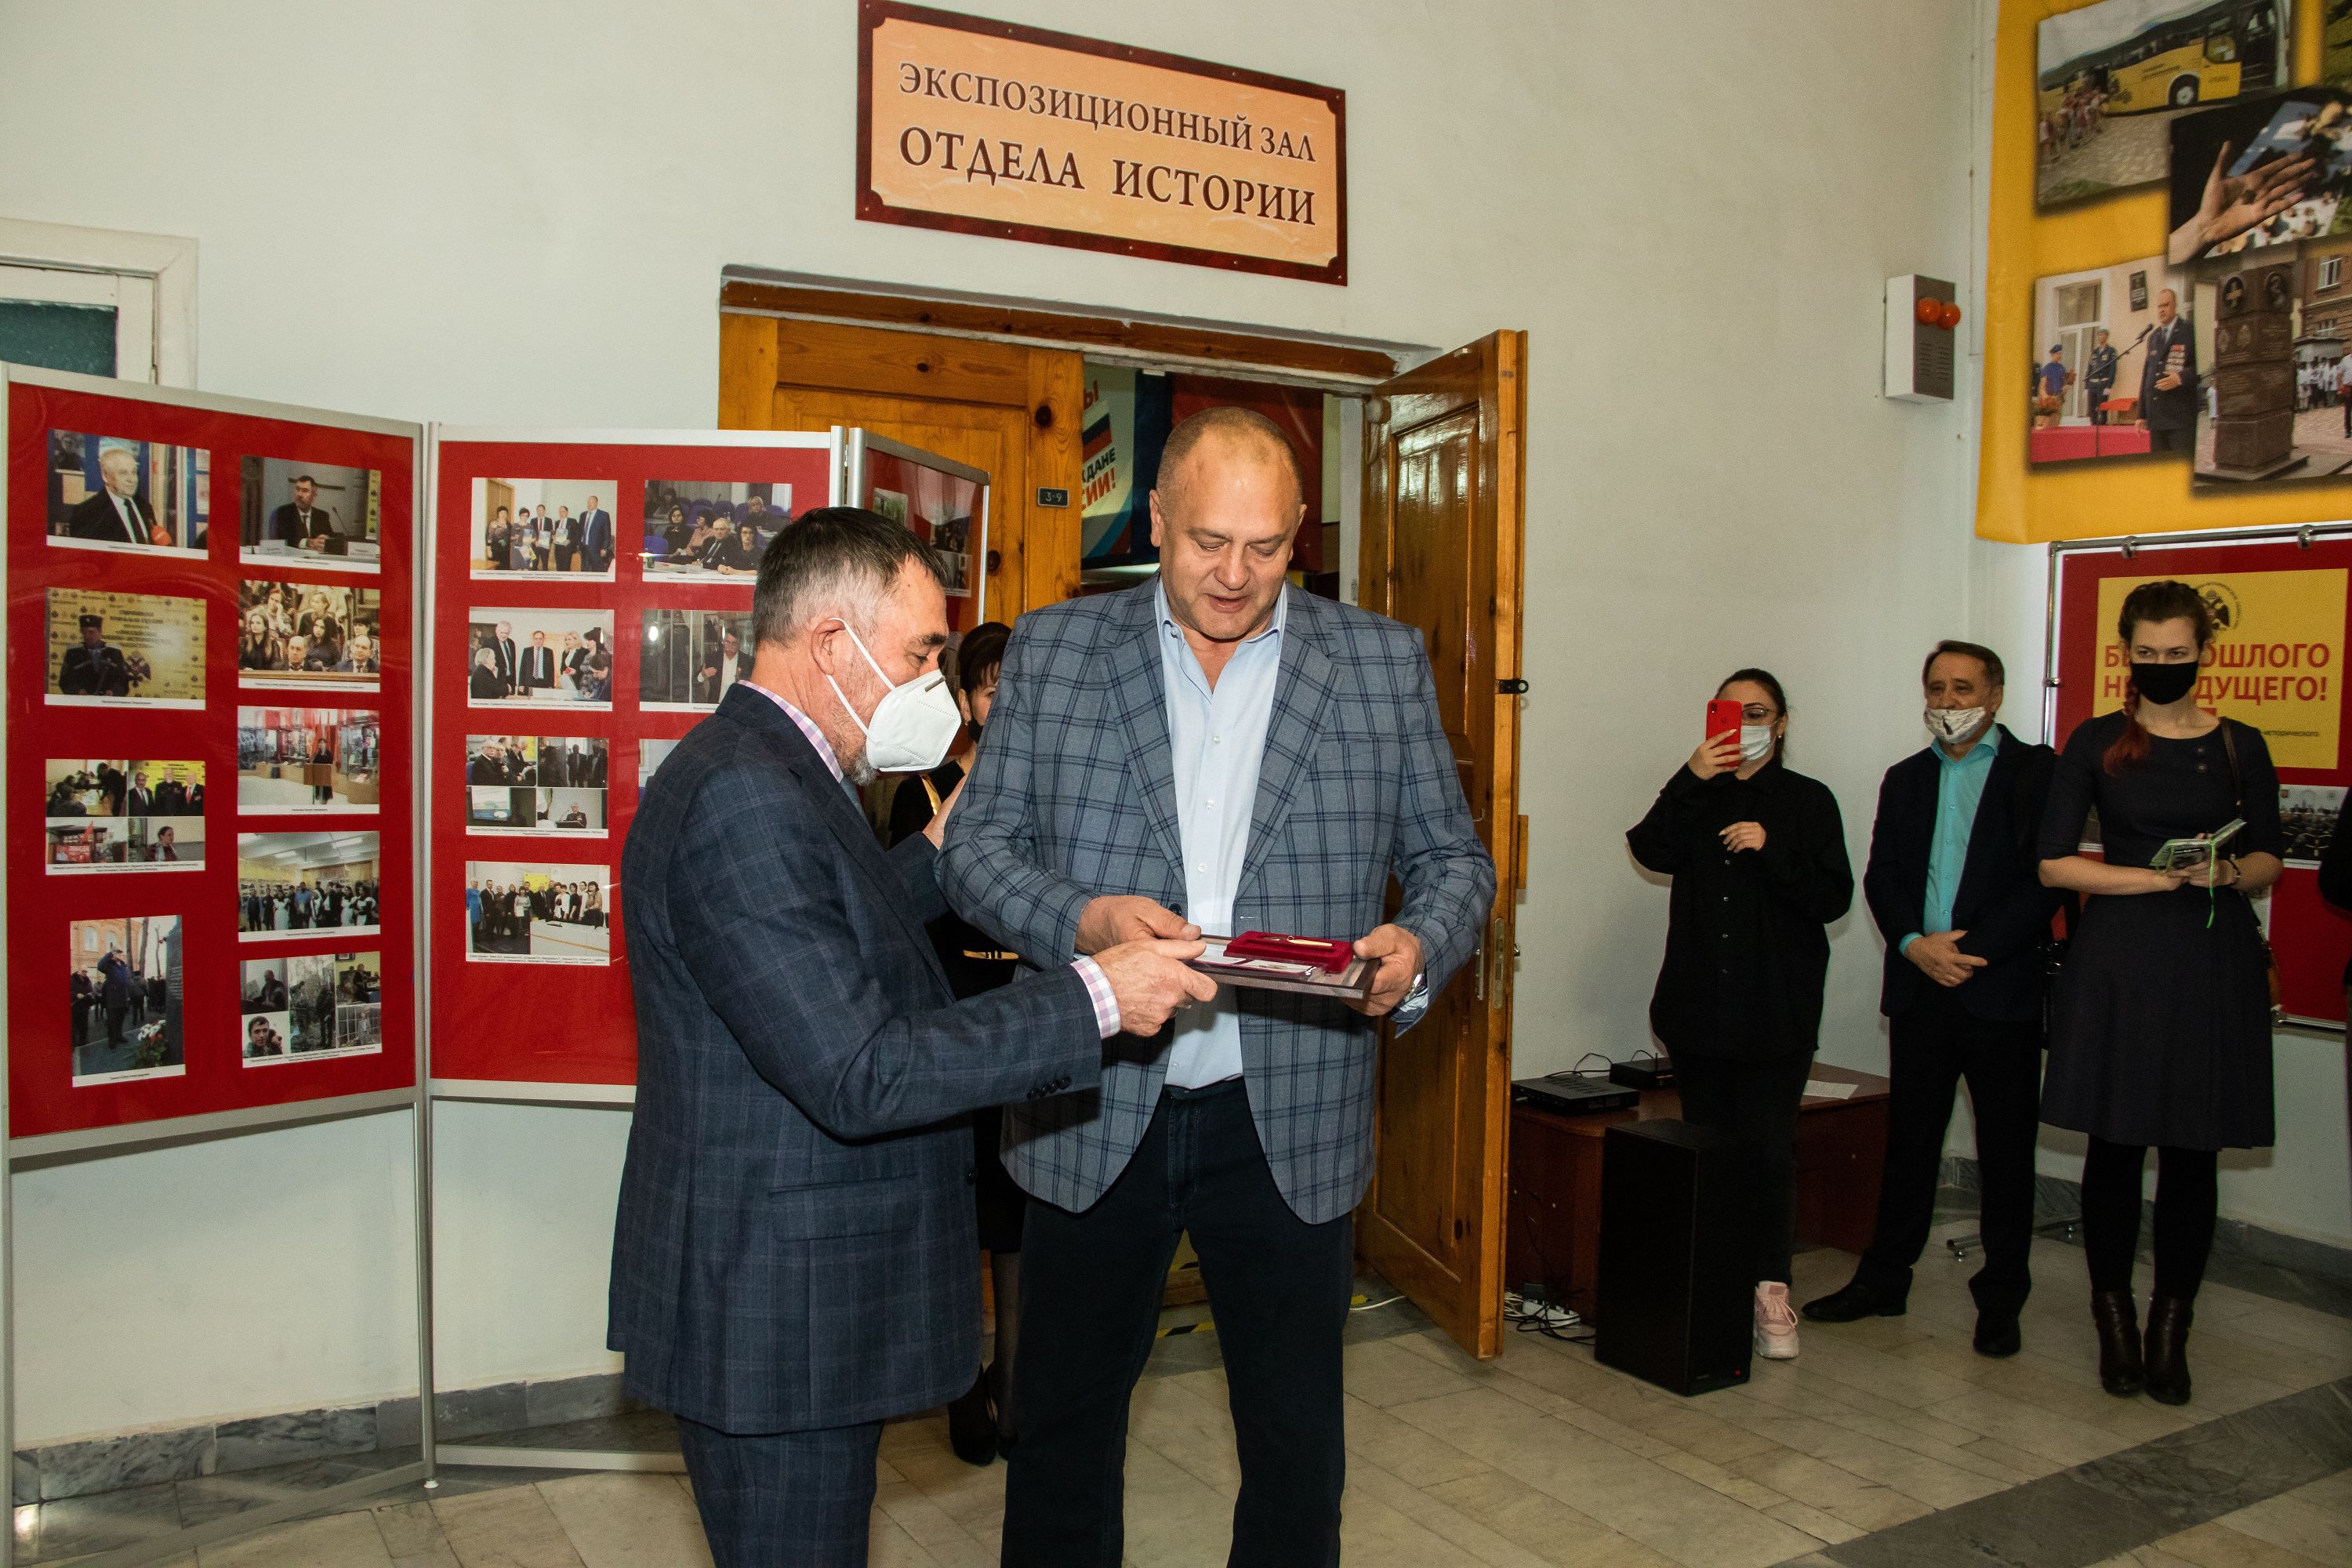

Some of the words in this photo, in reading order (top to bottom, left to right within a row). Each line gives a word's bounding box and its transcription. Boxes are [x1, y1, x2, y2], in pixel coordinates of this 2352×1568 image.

[899, 62, 1252, 151] ЭКСПОЗИЦИОННЫЙ
[1260, 126, 1316, 162] ЗАЛ
[899, 126, 1085, 190] ОТДЕЛА
[1112, 158, 1316, 225] ИСТОРИИ
[1046, 492, 1062, 503] 3-9
